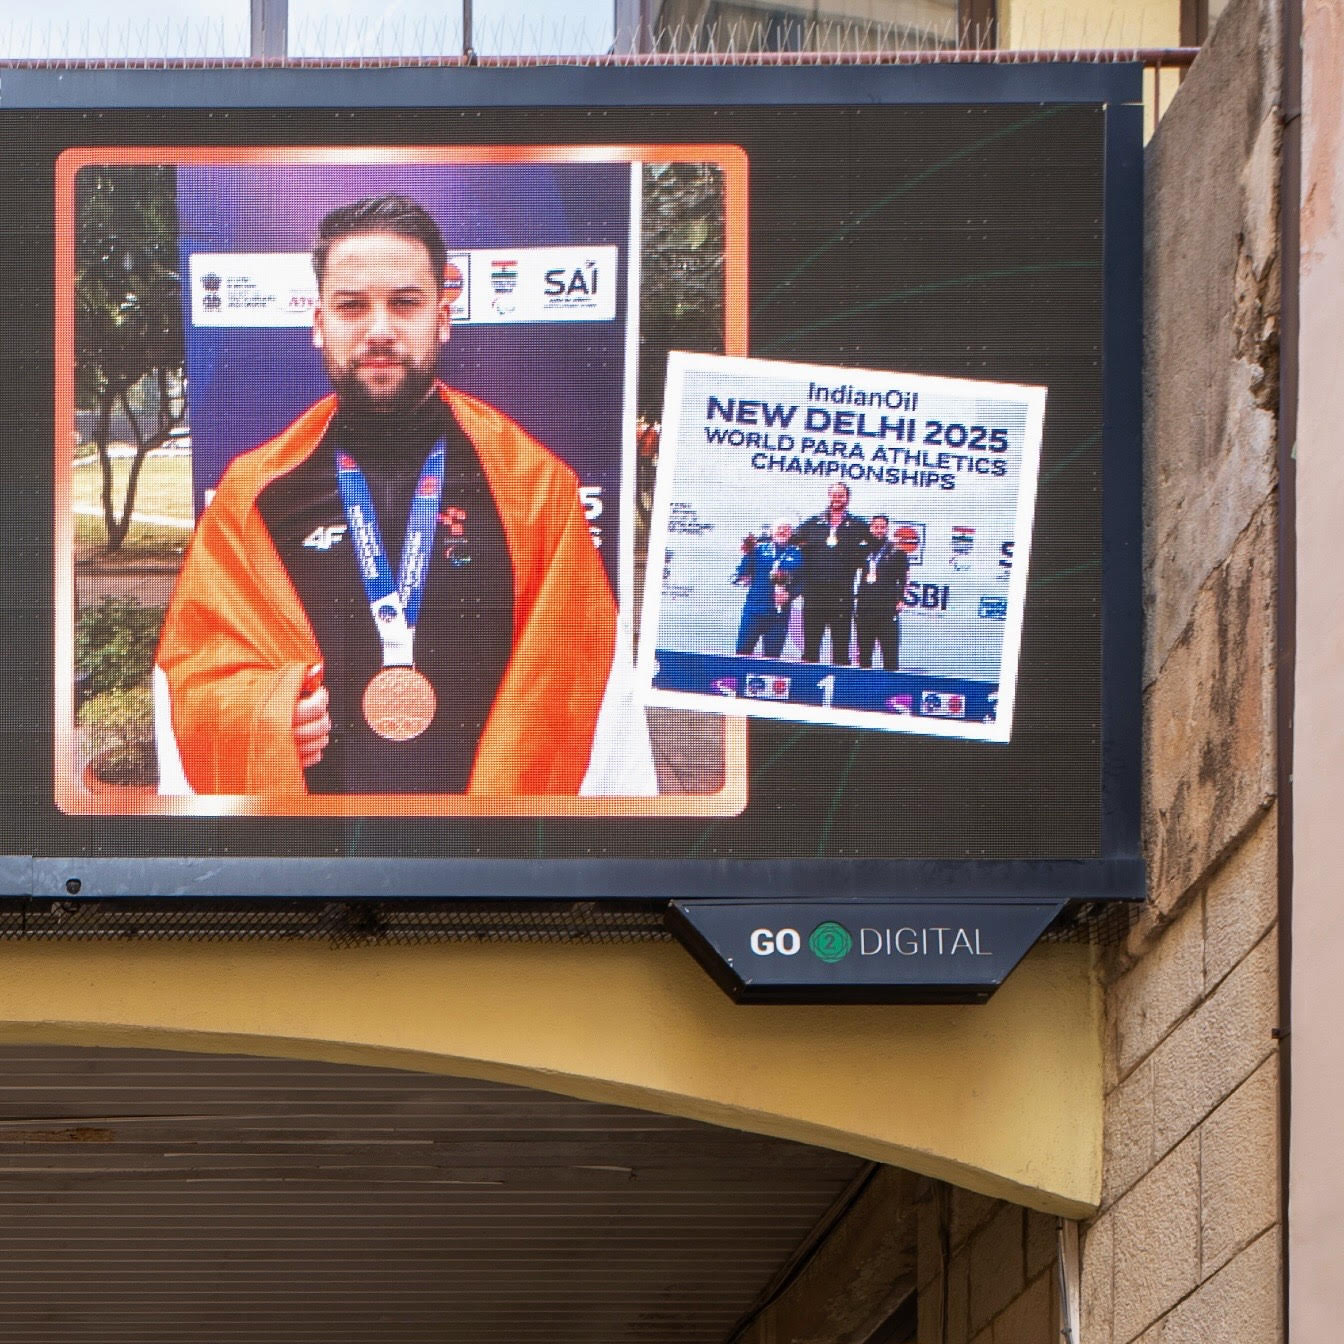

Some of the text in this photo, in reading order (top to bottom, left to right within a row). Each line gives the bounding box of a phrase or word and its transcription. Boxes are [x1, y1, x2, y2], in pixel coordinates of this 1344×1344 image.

[544, 264, 598, 297] SAI
[809, 381, 918, 411] IndianOil
[706, 395, 1008, 453] NEW DELHI 2025
[705, 426, 1007, 477] WORLD PARA ATHLETICS
[751, 452, 956, 491] CHAMPIONSHIPS
[903, 580, 949, 611] SBI
[750, 927, 801, 957] GO
[860, 927, 993, 957] DIGITAL
